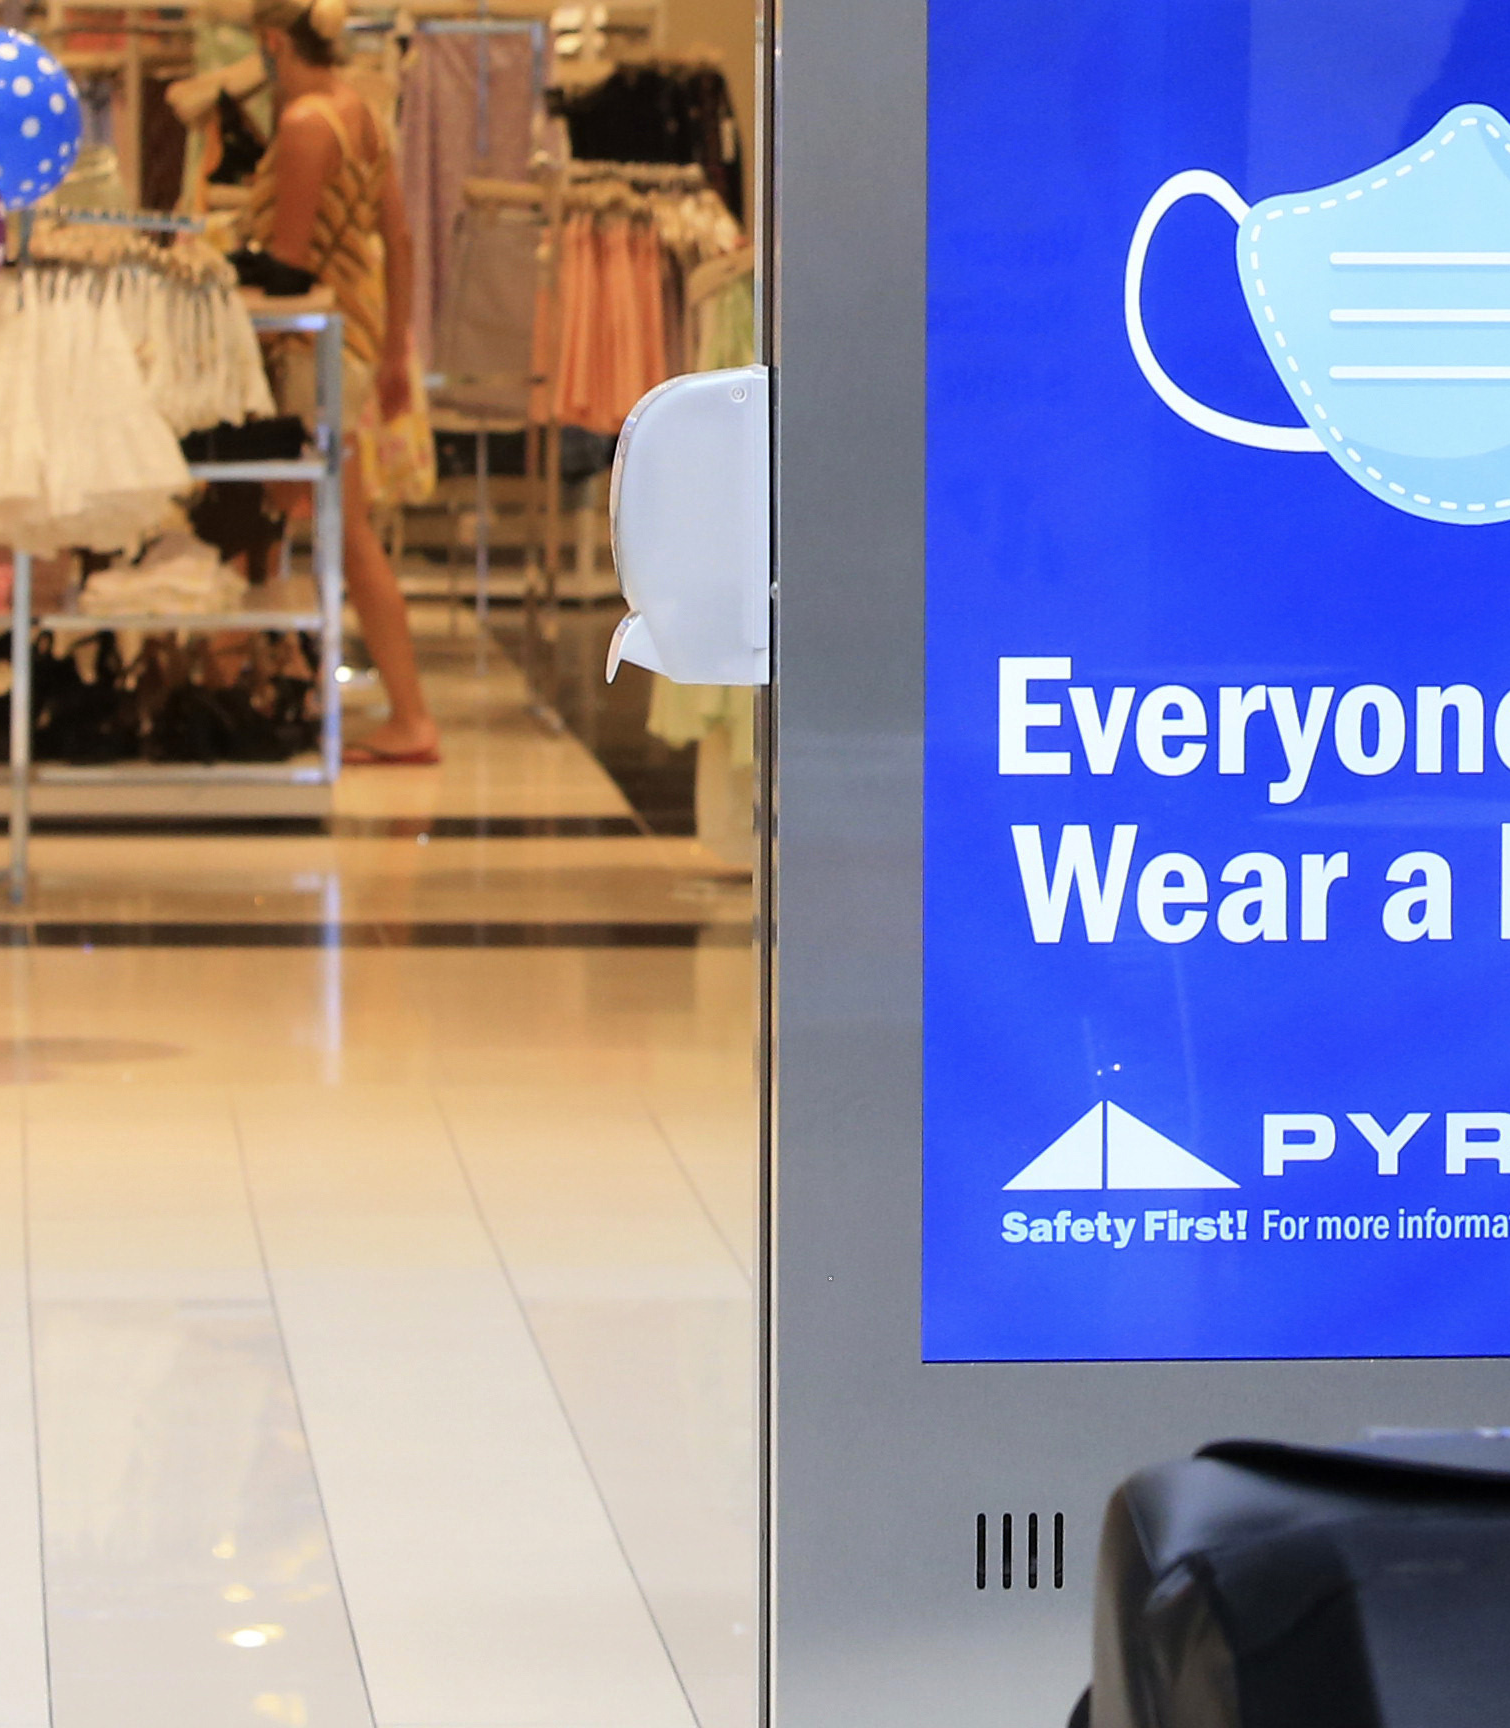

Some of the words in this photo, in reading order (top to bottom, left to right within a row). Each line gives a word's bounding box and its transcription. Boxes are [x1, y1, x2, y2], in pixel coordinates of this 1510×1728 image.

[1011, 825, 1348, 943] Wear
[1383, 852, 1452, 942] a
[1002, 1210, 1136, 1248] Safety
[1145, 1210, 1247, 1241] First!
[1264, 1210, 1309, 1240] For
[1317, 1216, 1389, 1239] more
